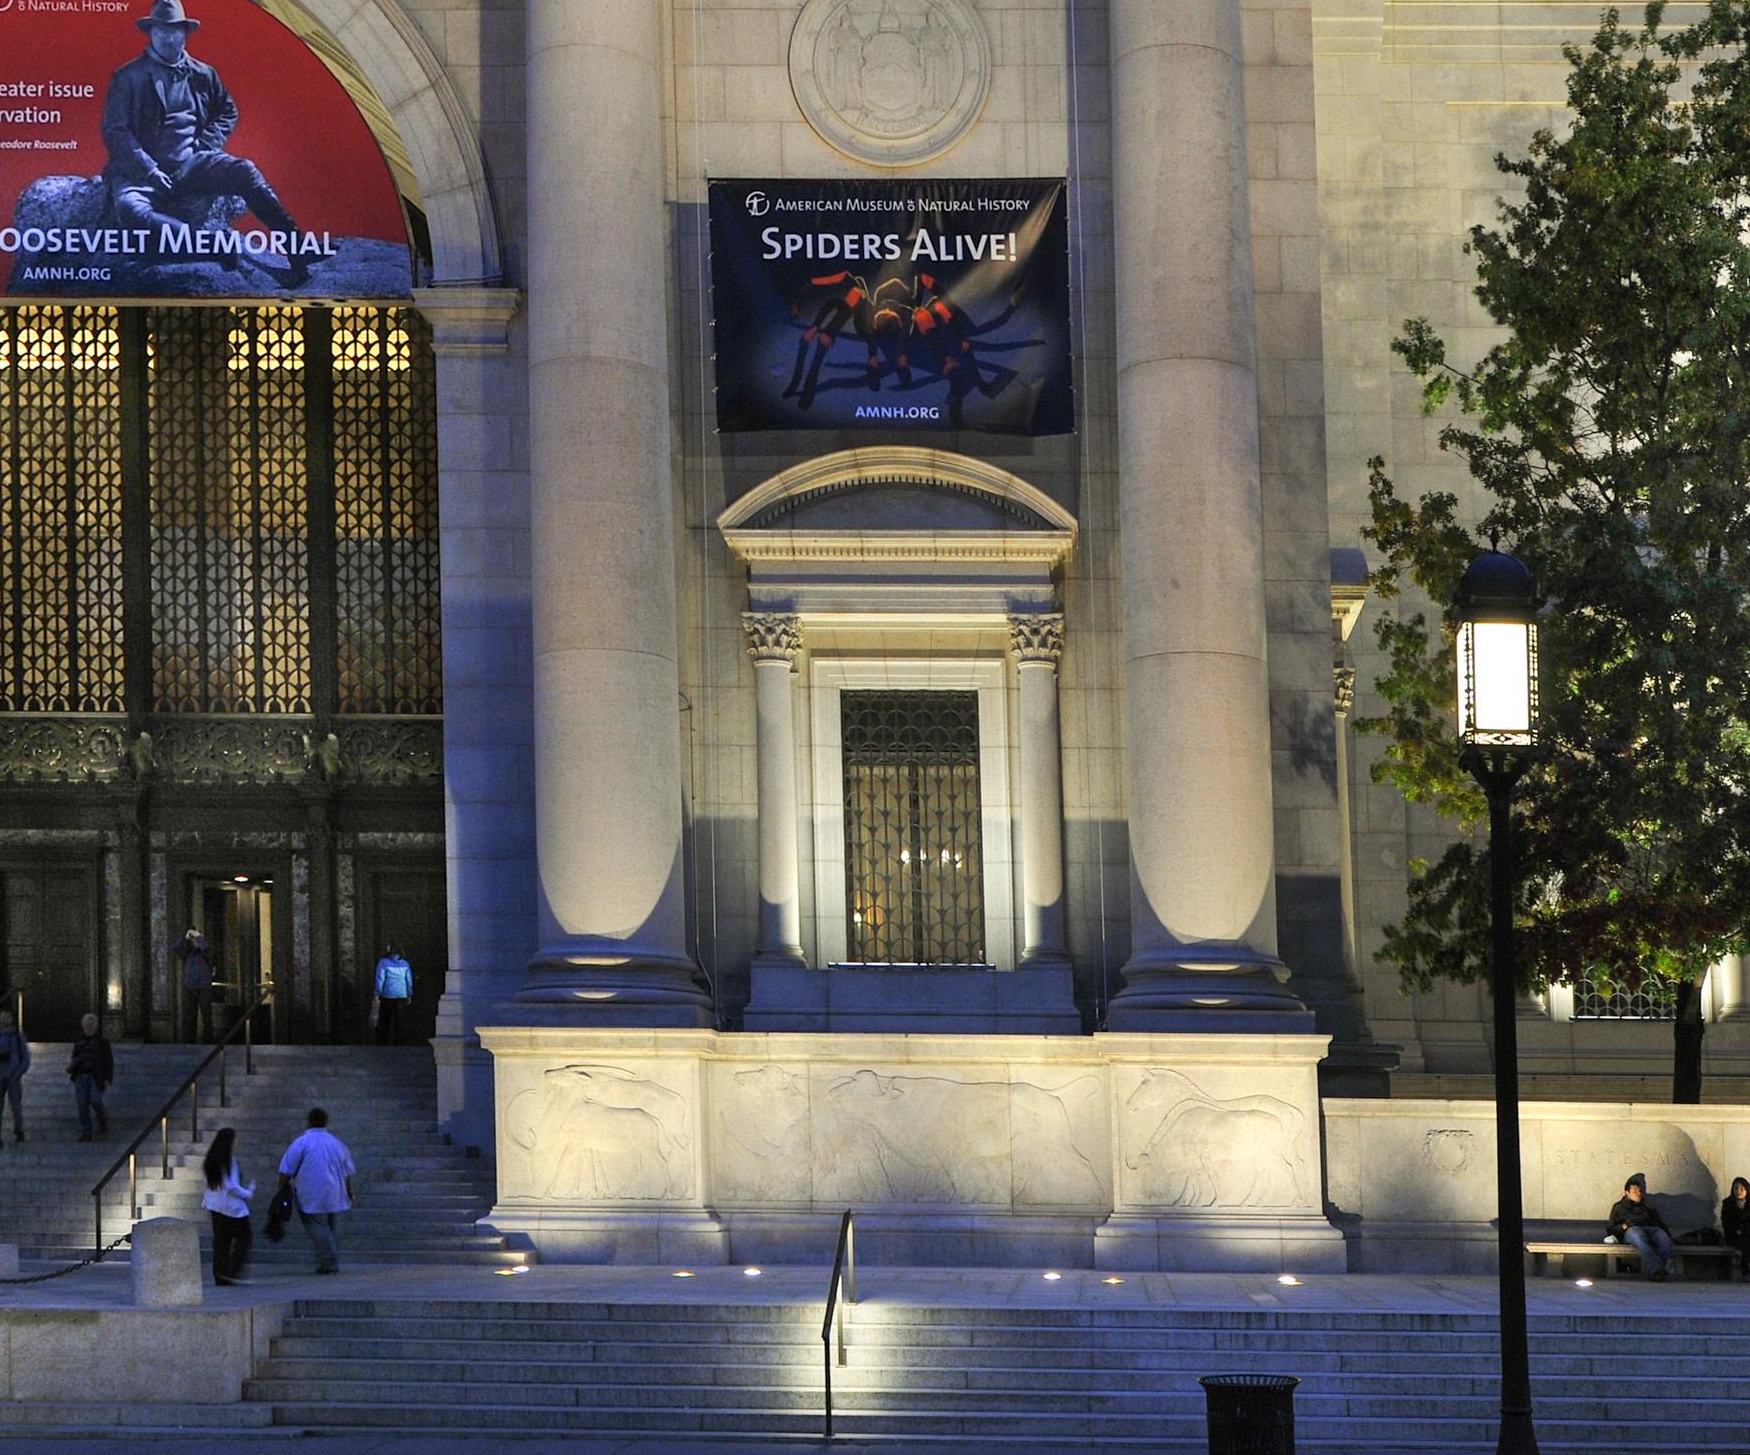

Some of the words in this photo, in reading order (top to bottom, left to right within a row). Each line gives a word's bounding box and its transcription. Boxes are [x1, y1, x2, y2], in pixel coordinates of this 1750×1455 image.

[28, 0, 80, 12] NATURAL
[82, 0, 130, 12] HISTORY
[48, 81, 95, 97] issue
[775, 198, 842, 212] AMERICAN
[846, 198, 904, 212] MUSEUM
[918, 198, 975, 213] NATURAL
[978, 198, 1031, 211] HISTORY
[158, 223, 338, 256] MEMORIAL
[761, 227, 901, 260] SPIDERS
[910, 228, 1017, 262] ALIVE!
[23, 266, 112, 282] AMNH.ORG
[855, 405, 940, 420] AMNH.ORG
